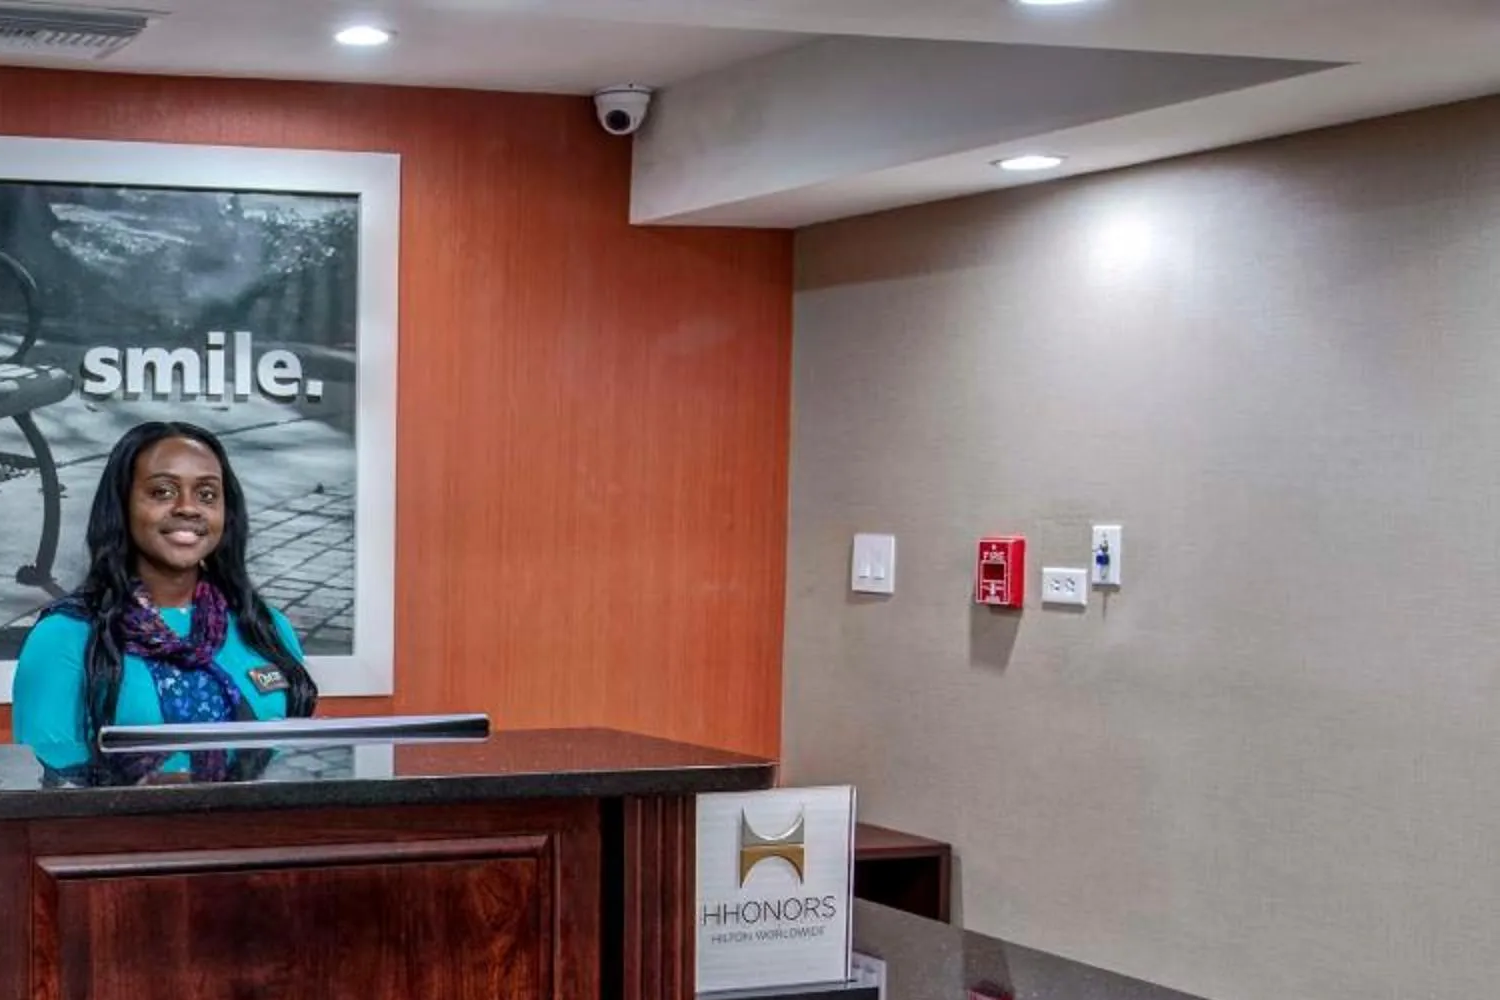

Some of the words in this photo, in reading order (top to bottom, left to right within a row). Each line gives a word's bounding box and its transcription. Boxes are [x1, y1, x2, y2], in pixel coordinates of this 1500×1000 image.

[82, 330, 324, 397] smile.
[702, 895, 837, 926] HHONORS
[711, 930, 753, 944] HILTON
[754, 925, 826, 941] WORLDWIDE
